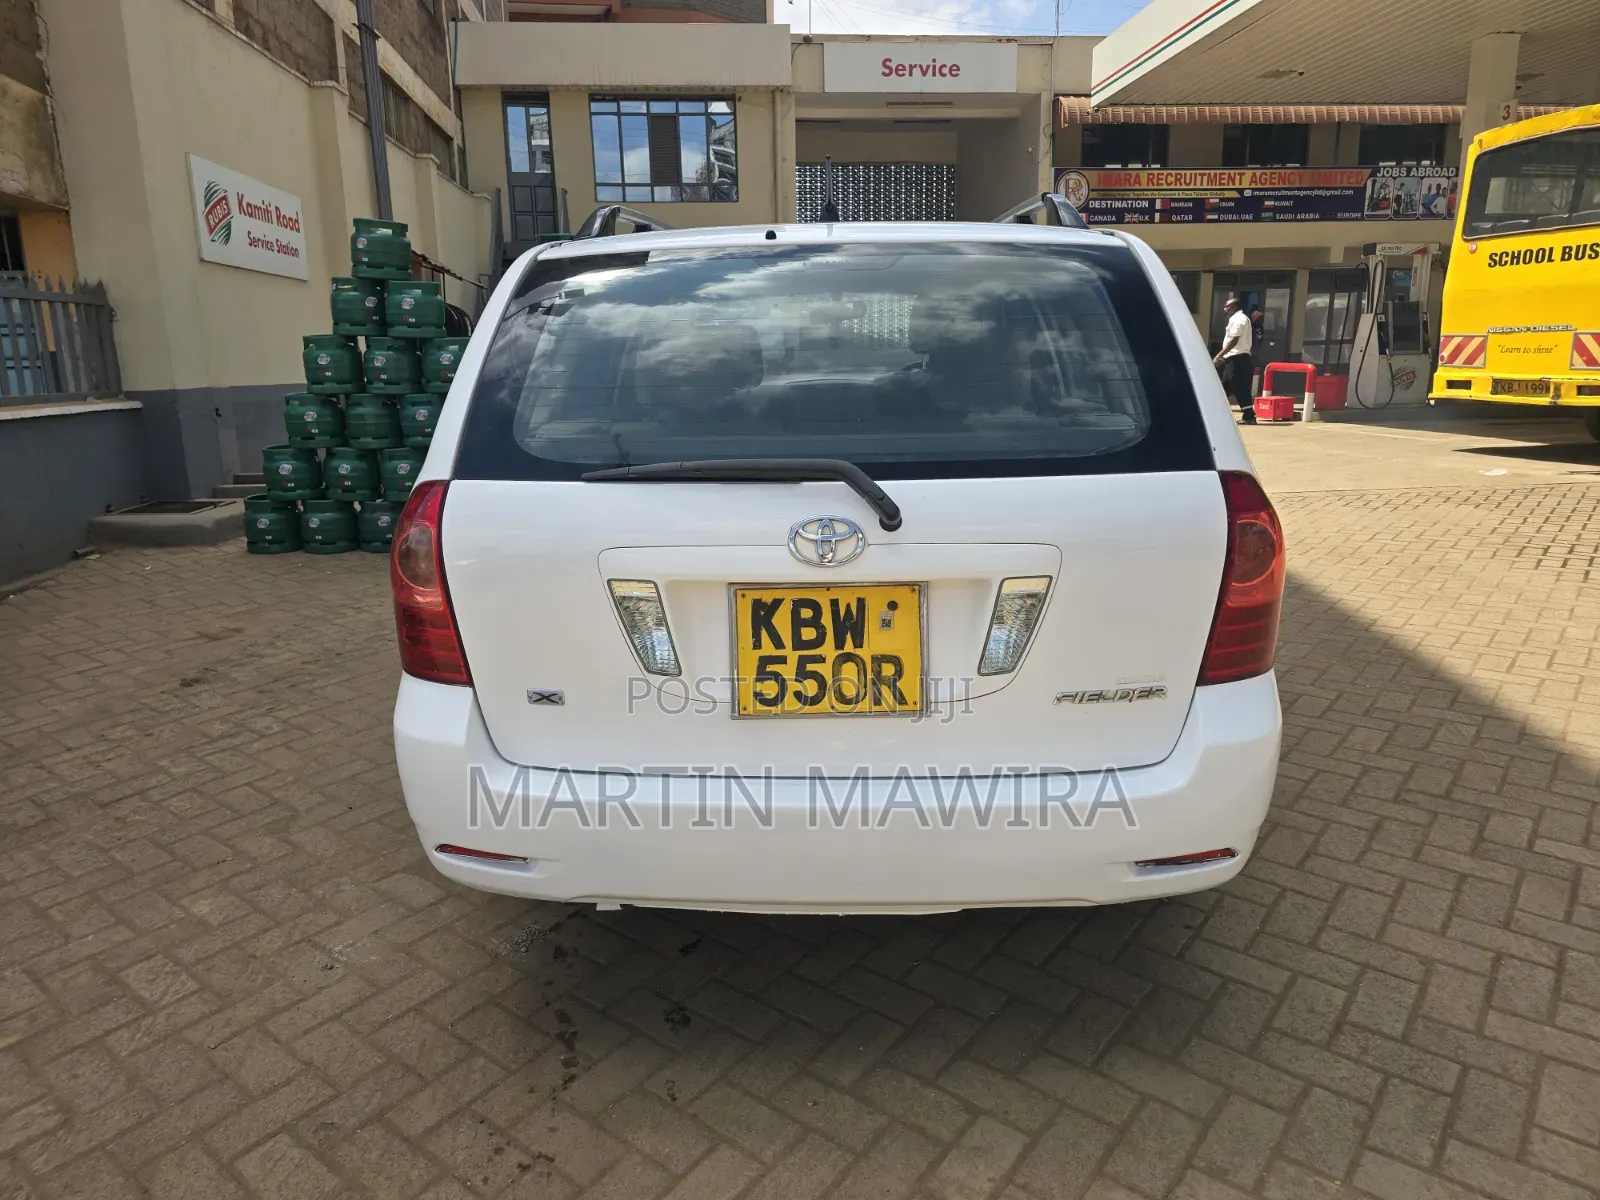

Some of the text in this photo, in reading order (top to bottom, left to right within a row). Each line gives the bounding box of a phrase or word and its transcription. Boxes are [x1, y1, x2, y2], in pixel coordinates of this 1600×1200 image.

[881, 57, 961, 78] Service
[1502, 104, 1511, 121] 3
[1097, 170, 1364, 187] IARA RECRUITMENT AGENCY LIMITED
[1376, 167, 1457, 177] JOBS ABROAD
[236, 191, 301, 234] Kamiti Road
[1088, 200, 1149, 208] DESTINATION
[1275, 212, 1295, 220] SAUDI
[247, 230, 300, 259] Service Station
[1487, 242, 1600, 268] SCHOOL BUS
[1487, 325, 1528, 333] NISSAN
[1523, 346, 1530, 354] to
[750, 596, 867, 652] KBW
[752, 651, 909, 708] 550R
[1052, 684, 1168, 706] FIELDER
